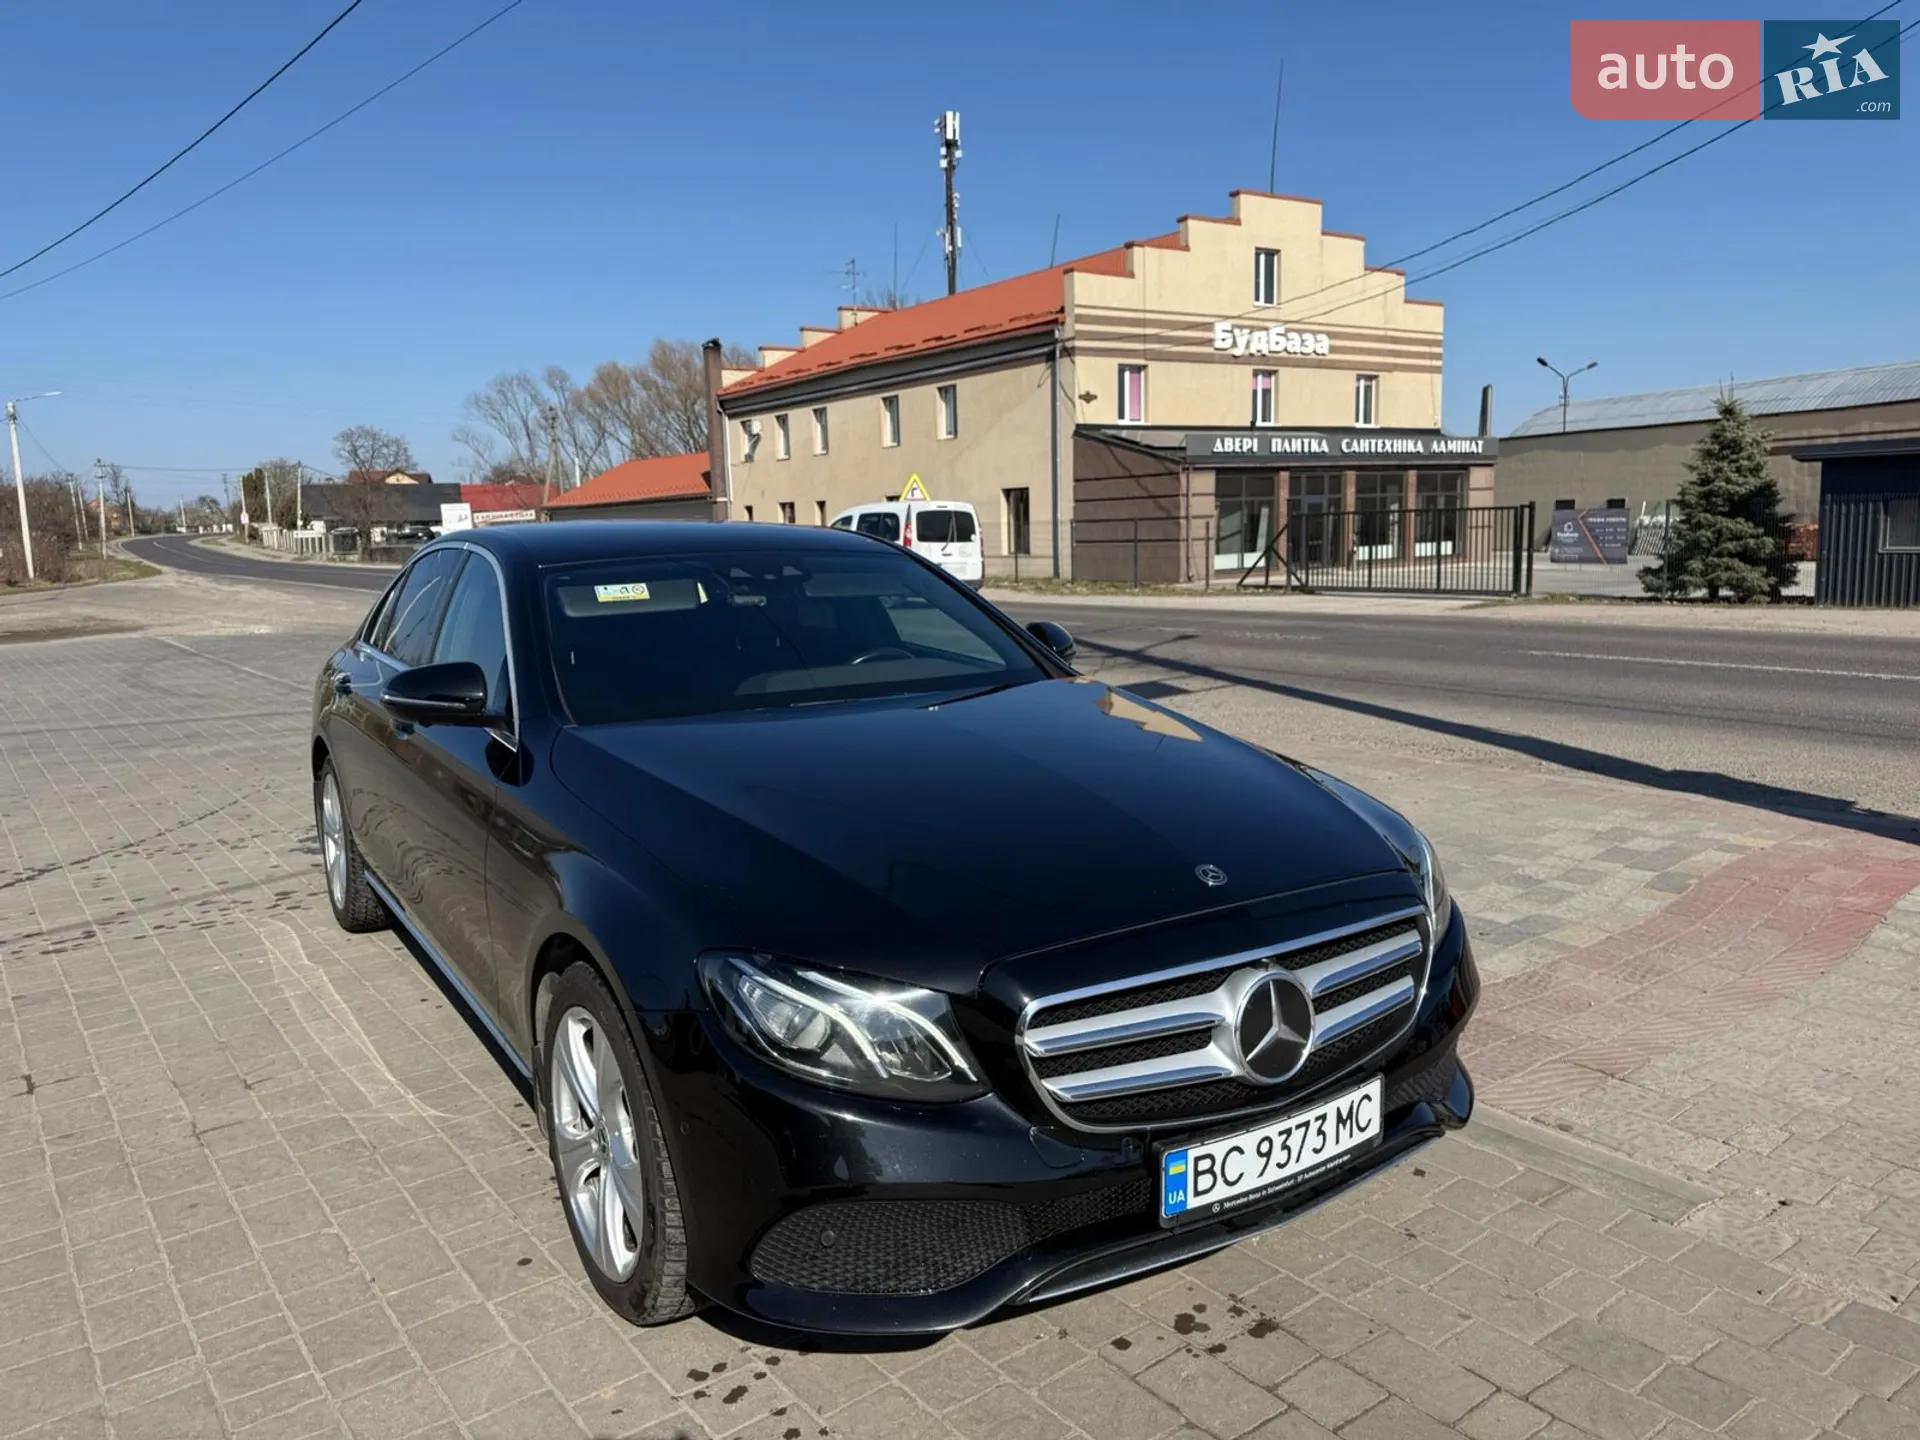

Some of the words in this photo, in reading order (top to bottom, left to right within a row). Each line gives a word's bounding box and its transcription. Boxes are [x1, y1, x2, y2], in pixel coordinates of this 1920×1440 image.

[1213, 321, 1329, 357] БудБаза
[1213, 437, 1258, 453] ДВЕРІ
[1271, 438, 1329, 453] ПЛИТКА
[1341, 438, 1424, 454] САНТЕХНІКА
[1431, 440, 1484, 454] ЛАМІНАТ
[1193, 1145, 1245, 1198] BC
[1256, 1112, 1327, 1178] 9373
[1335, 1093, 1373, 1145] MC
[1168, 1189, 1185, 1205] UA
